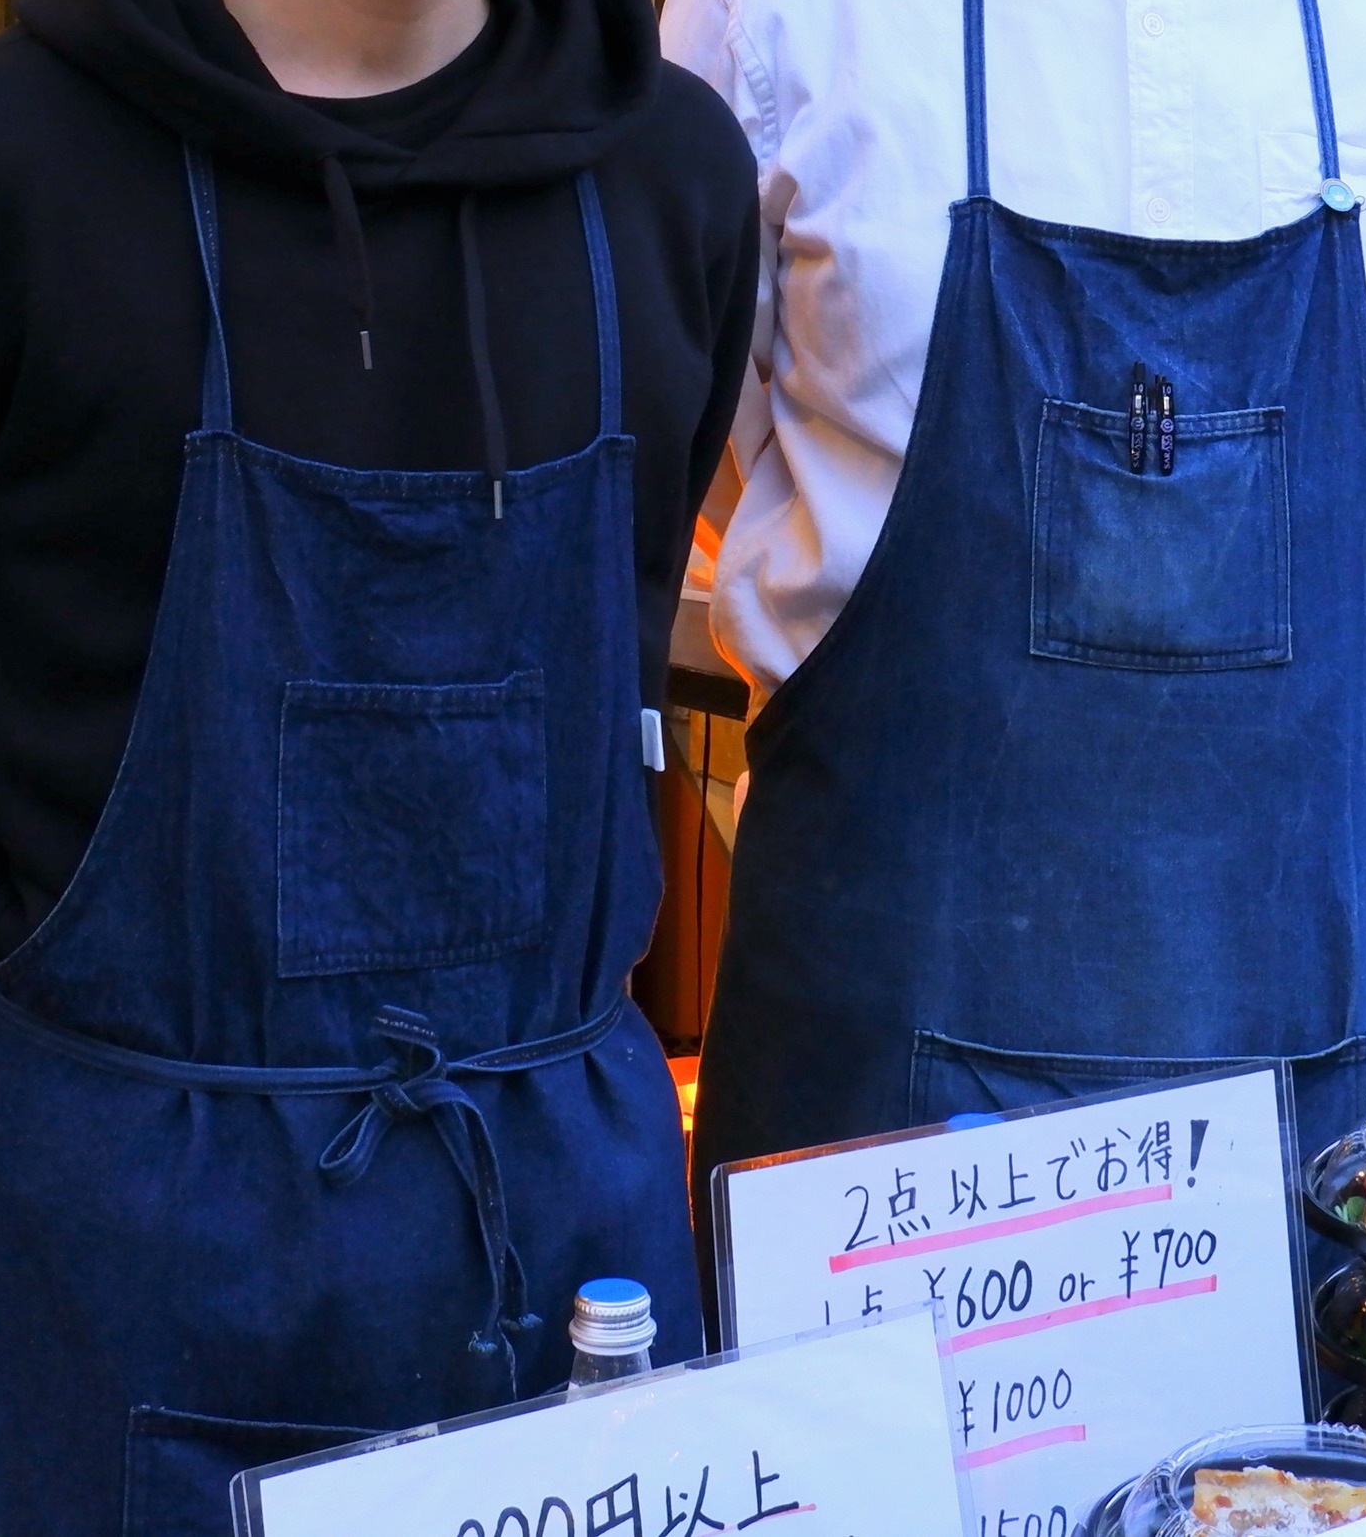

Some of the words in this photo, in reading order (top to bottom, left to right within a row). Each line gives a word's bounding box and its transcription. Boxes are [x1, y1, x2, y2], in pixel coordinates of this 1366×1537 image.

[1059, 1272, 1096, 1303] or
[1119, 1229, 1217, 1298] ¥700
[958, 1367, 1072, 1447] ¥1000
